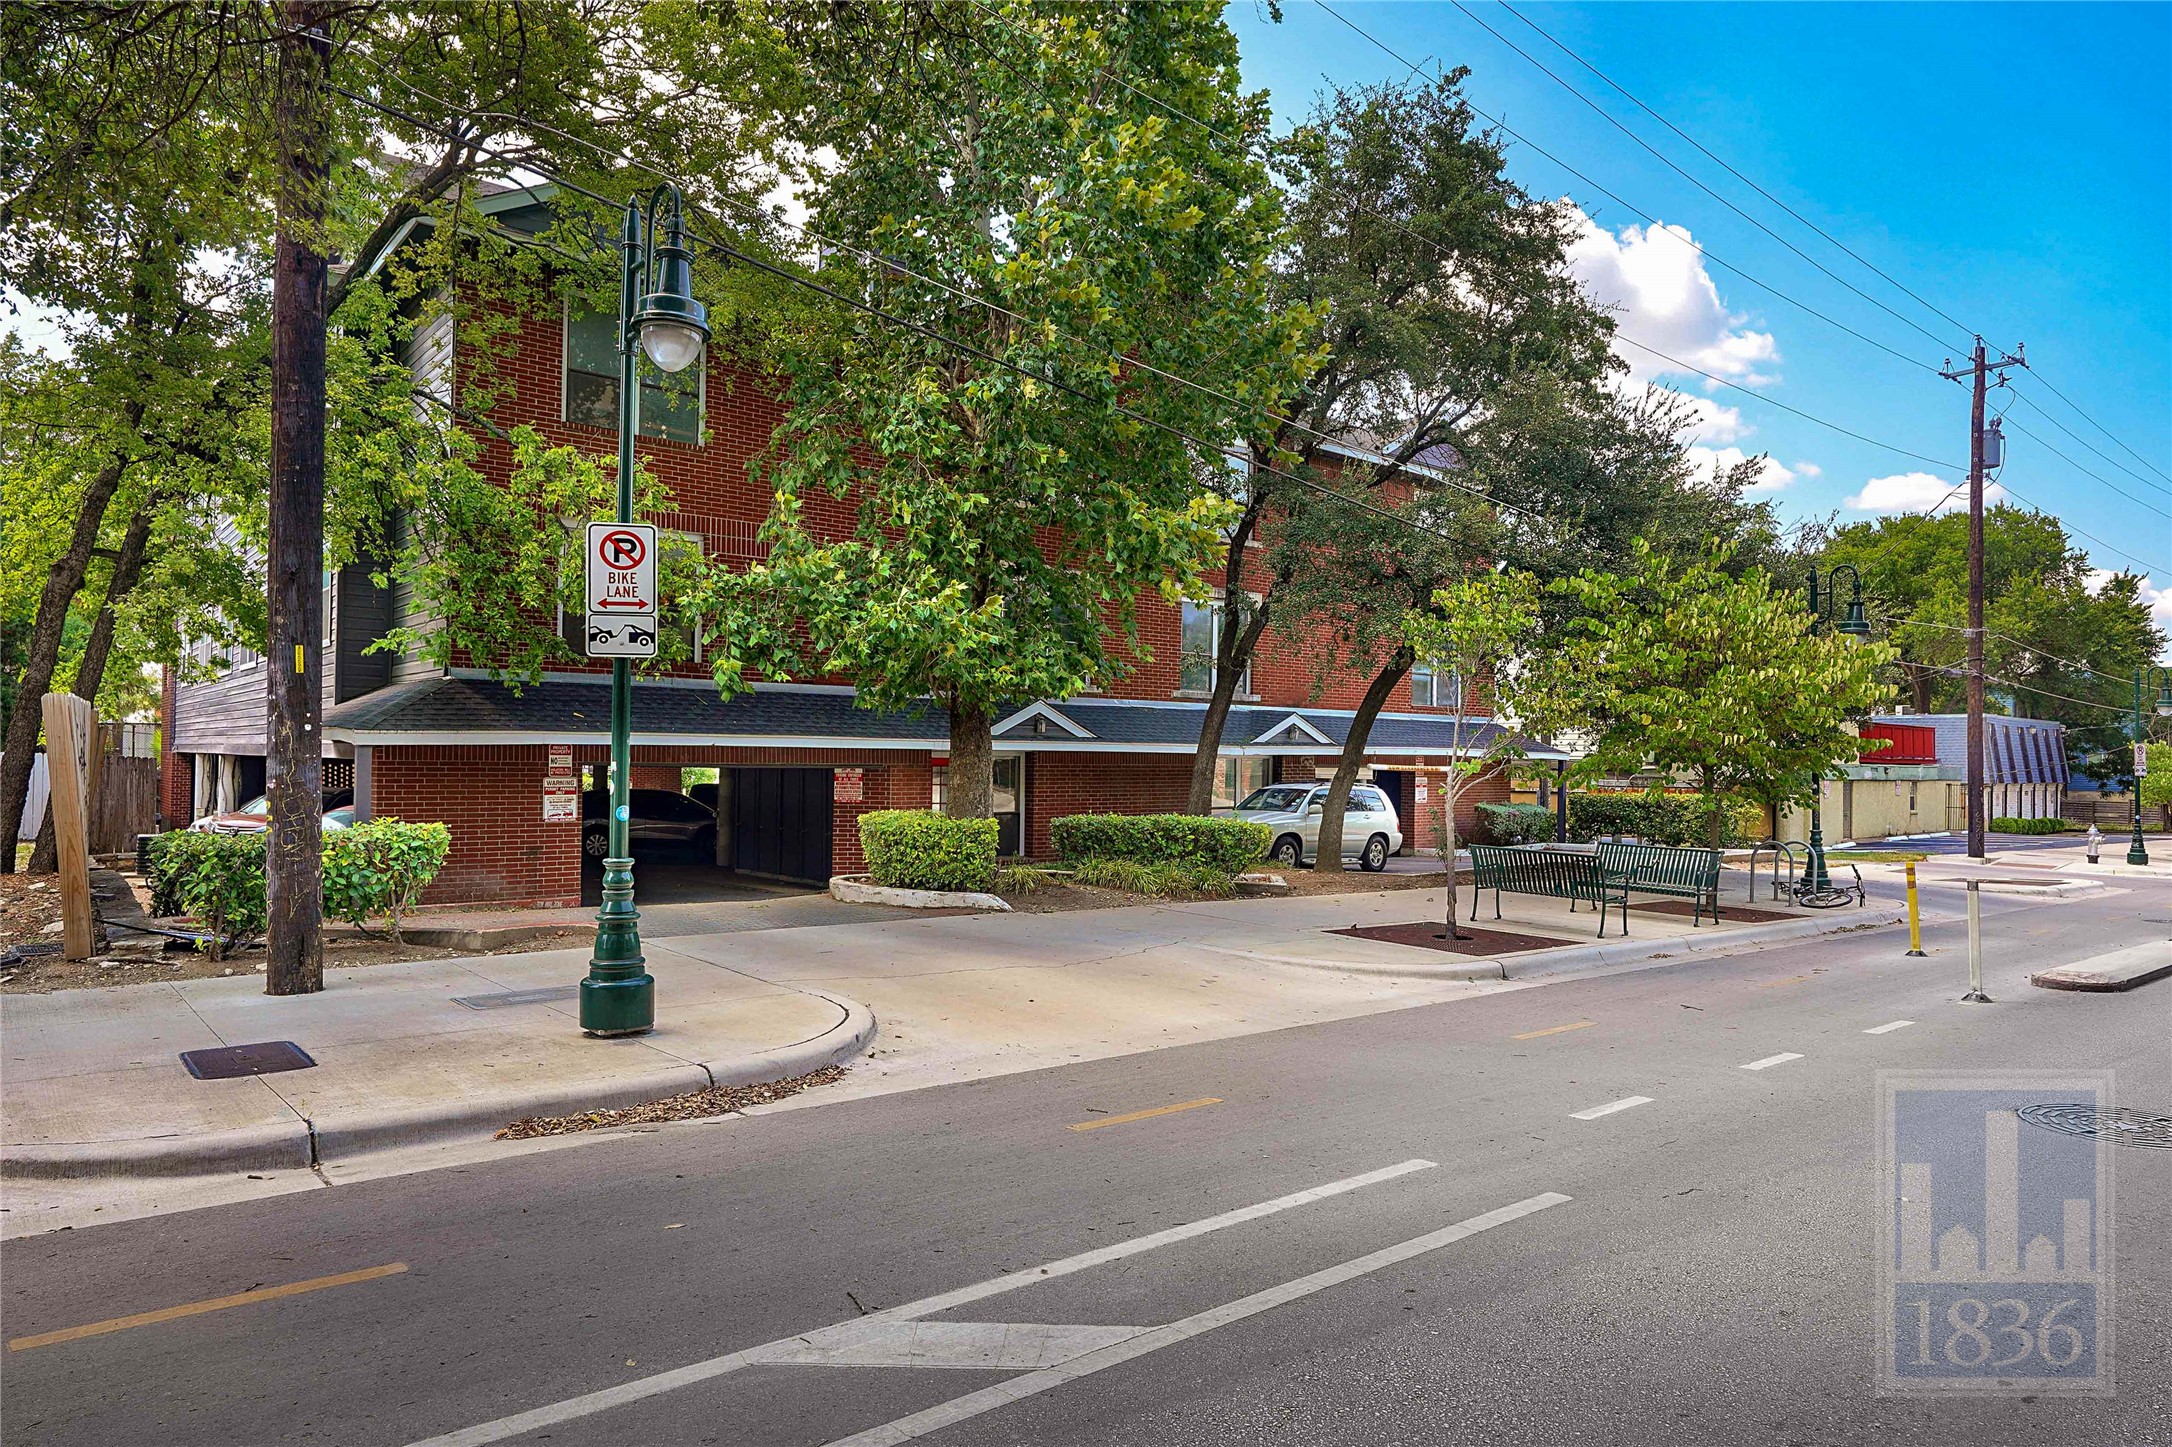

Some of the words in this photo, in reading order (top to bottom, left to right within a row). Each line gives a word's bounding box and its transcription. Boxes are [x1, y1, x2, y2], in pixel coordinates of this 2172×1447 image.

[608, 572, 637, 584] BIKE
[606, 586, 639, 598] LANE
[550, 757, 558, 765] NO
